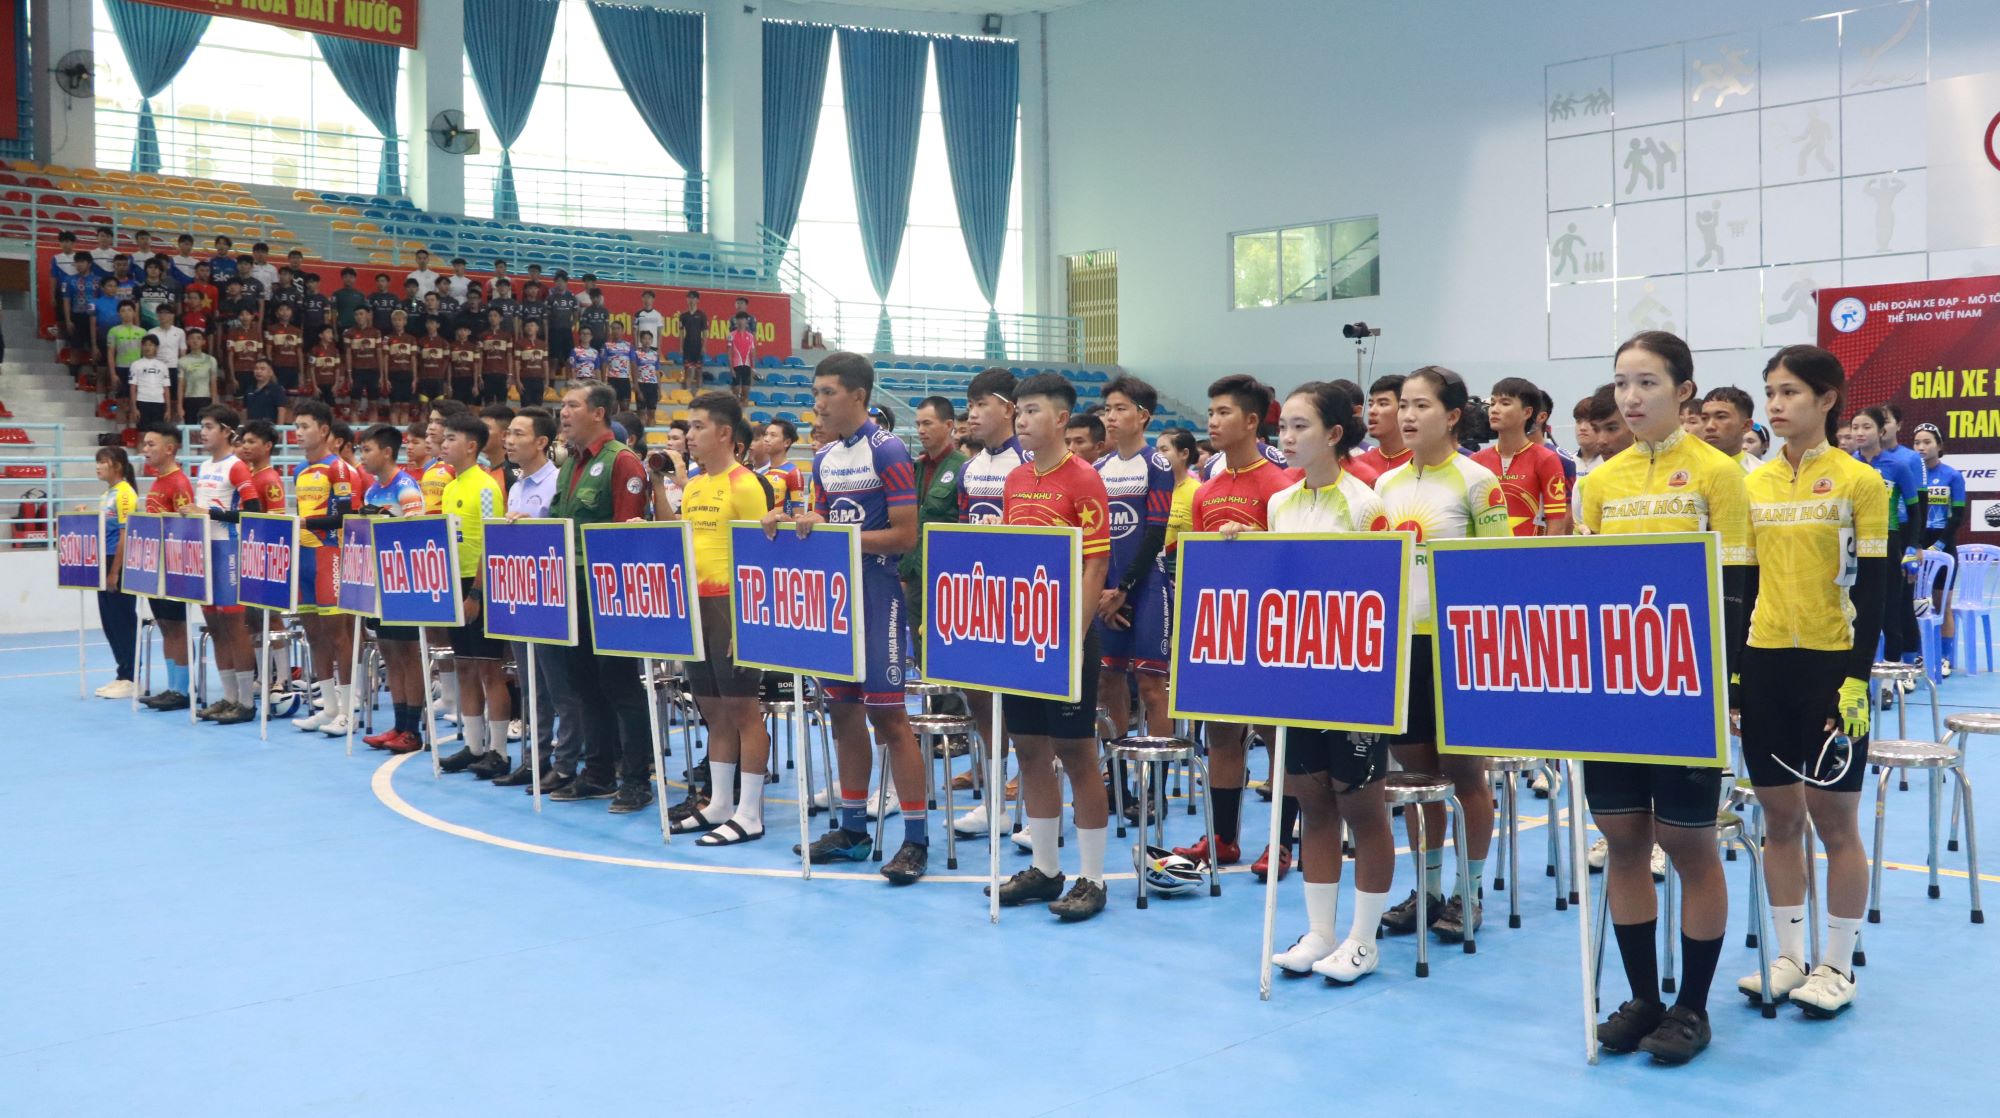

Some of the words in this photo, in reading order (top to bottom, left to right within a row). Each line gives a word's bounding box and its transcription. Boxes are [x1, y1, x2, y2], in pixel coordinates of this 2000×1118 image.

[1869, 300, 1889, 312] LIÊN
[1890, 299, 1921, 310] ĐOÀN
[1923, 299, 1936, 308] XE
[1938, 297, 1959, 310] ĐẠP
[1906, 312, 1933, 322] THAO
[1935, 310, 1955, 322] VIỆT
[1957, 309, 1982, 319] NAM
[1910, 366, 1954, 400] GIẢI
[1960, 368, 1989, 398] XE
[1228, 495, 1248, 504] KHU
[1653, 496, 1697, 516] HÓA
[1800, 502, 1840, 521] HÓA
[60, 531, 82, 566] SƠN
[84, 534, 98, 567] LA
[184, 541, 205, 578] LONG
[241, 529, 266, 580] ĐỒNG
[266, 536, 290, 584] THÁP
[362, 544, 376, 586] NA
[380, 542, 410, 593] HÀ
[410, 538, 449, 602] NỘI
[488, 554, 538, 614] TRỌNG
[539, 546, 566, 608] TÀI
[592, 562, 622, 616] TP.
[624, 562, 670, 618] HCM
[671, 564, 686, 619] 1
[738, 564, 770, 626] TP.
[773, 567, 826, 632] HCM
[832, 571, 848, 634] 2
[936, 560, 1006, 646] QUÂN
[1012, 565, 1060, 662] ĐỘI
[1190, 588, 1249, 665] AN
[1256, 588, 1385, 672] GIANG
[1446, 604, 1592, 694] THANH
[1600, 584, 1702, 697] HÓA
